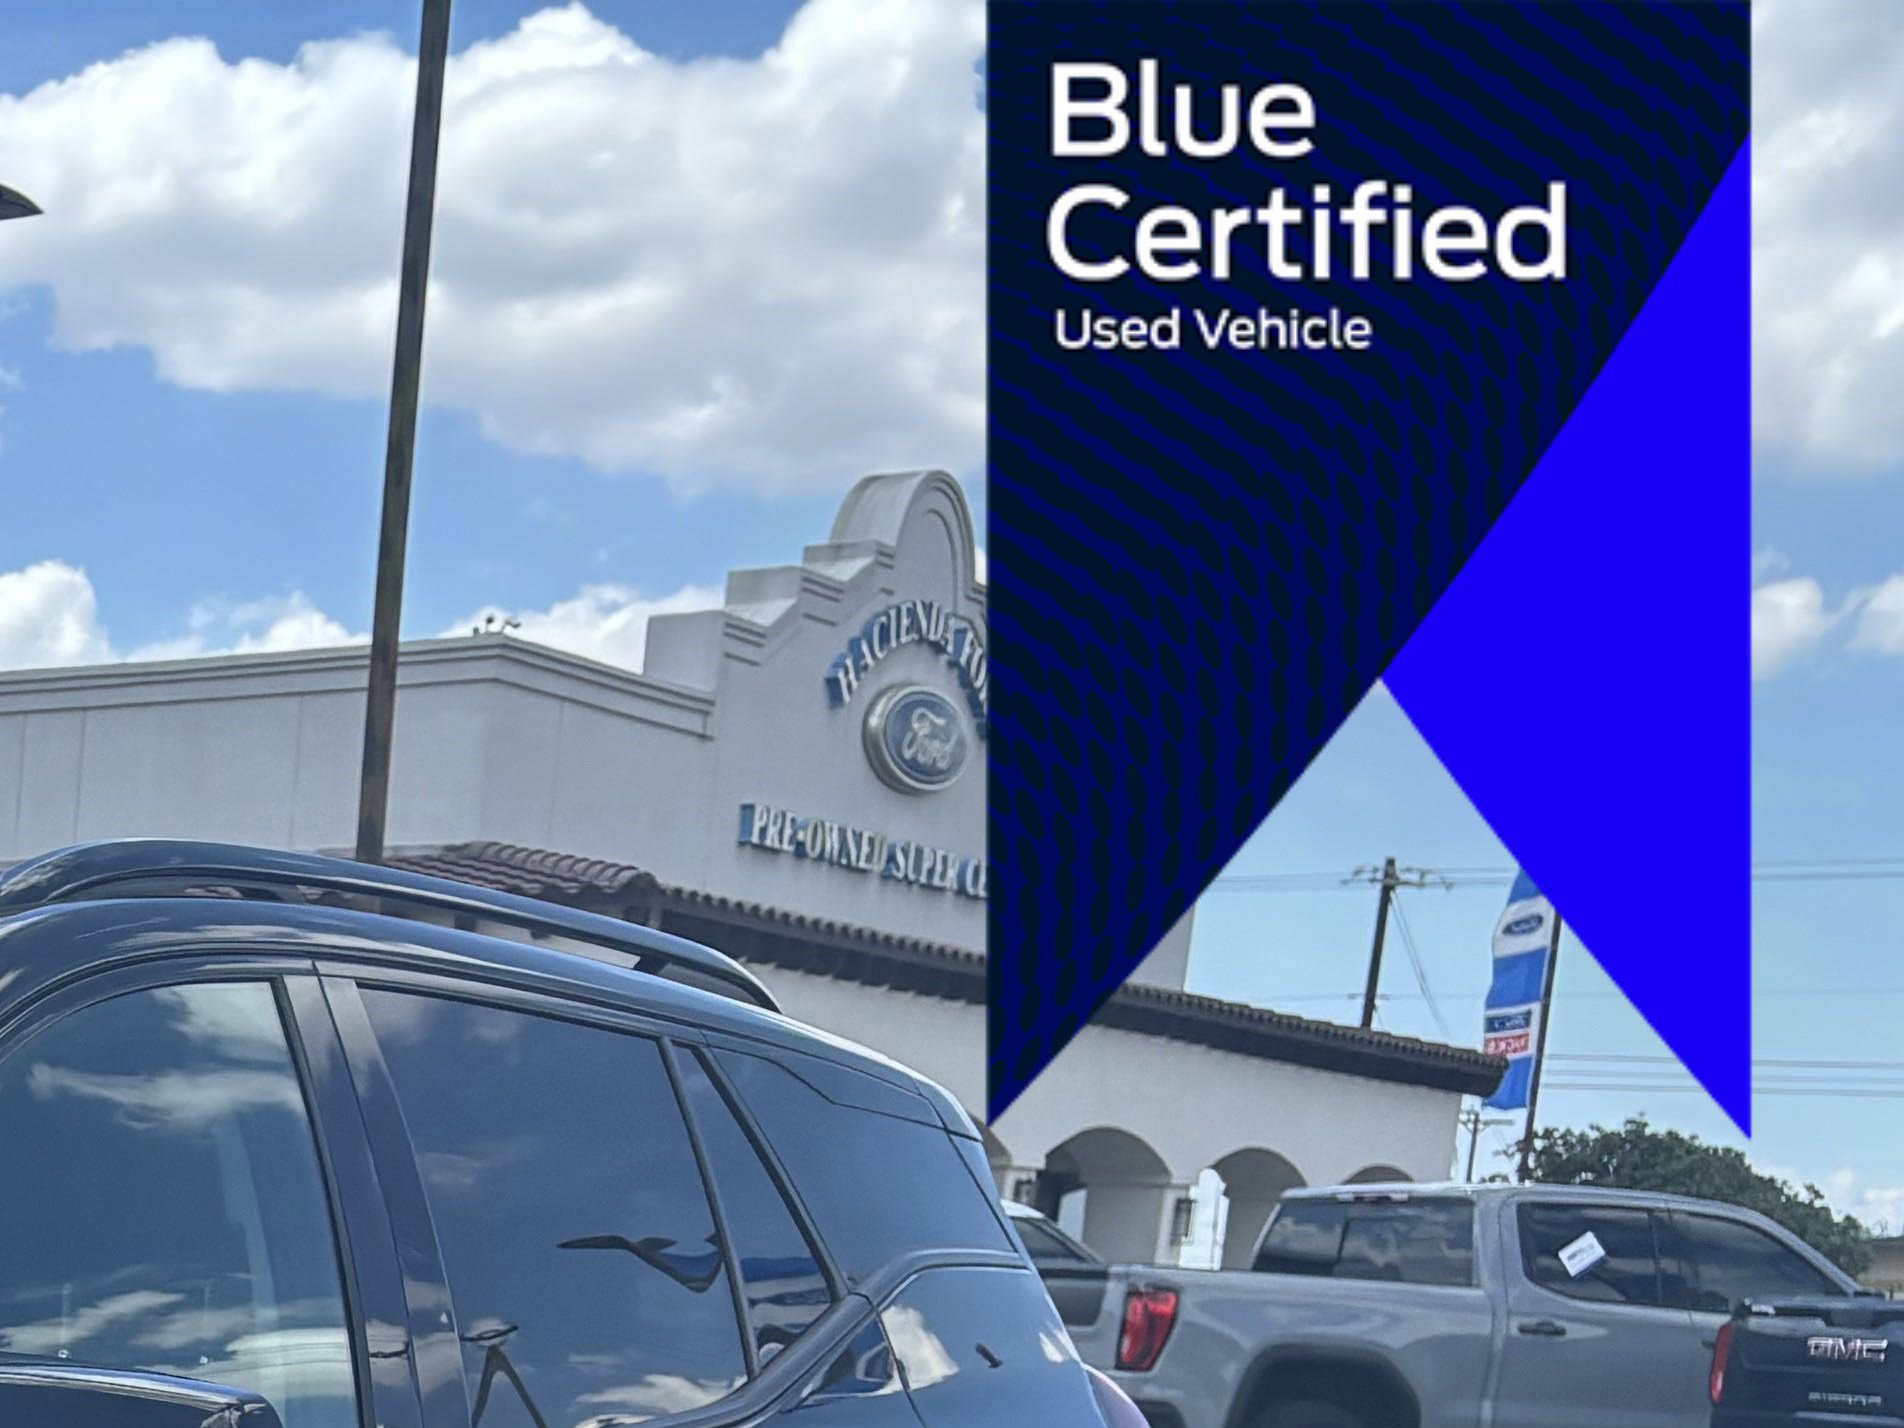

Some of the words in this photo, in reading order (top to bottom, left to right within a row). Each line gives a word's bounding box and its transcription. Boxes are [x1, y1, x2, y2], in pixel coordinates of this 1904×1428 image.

[829, 600, 955, 704] HACIENDA
[742, 804, 888, 875] PRE-OWNED
[892, 841, 959, 892] SUPER
[963, 859, 987, 899] CE
[1807, 1336, 1888, 1362] GMC
